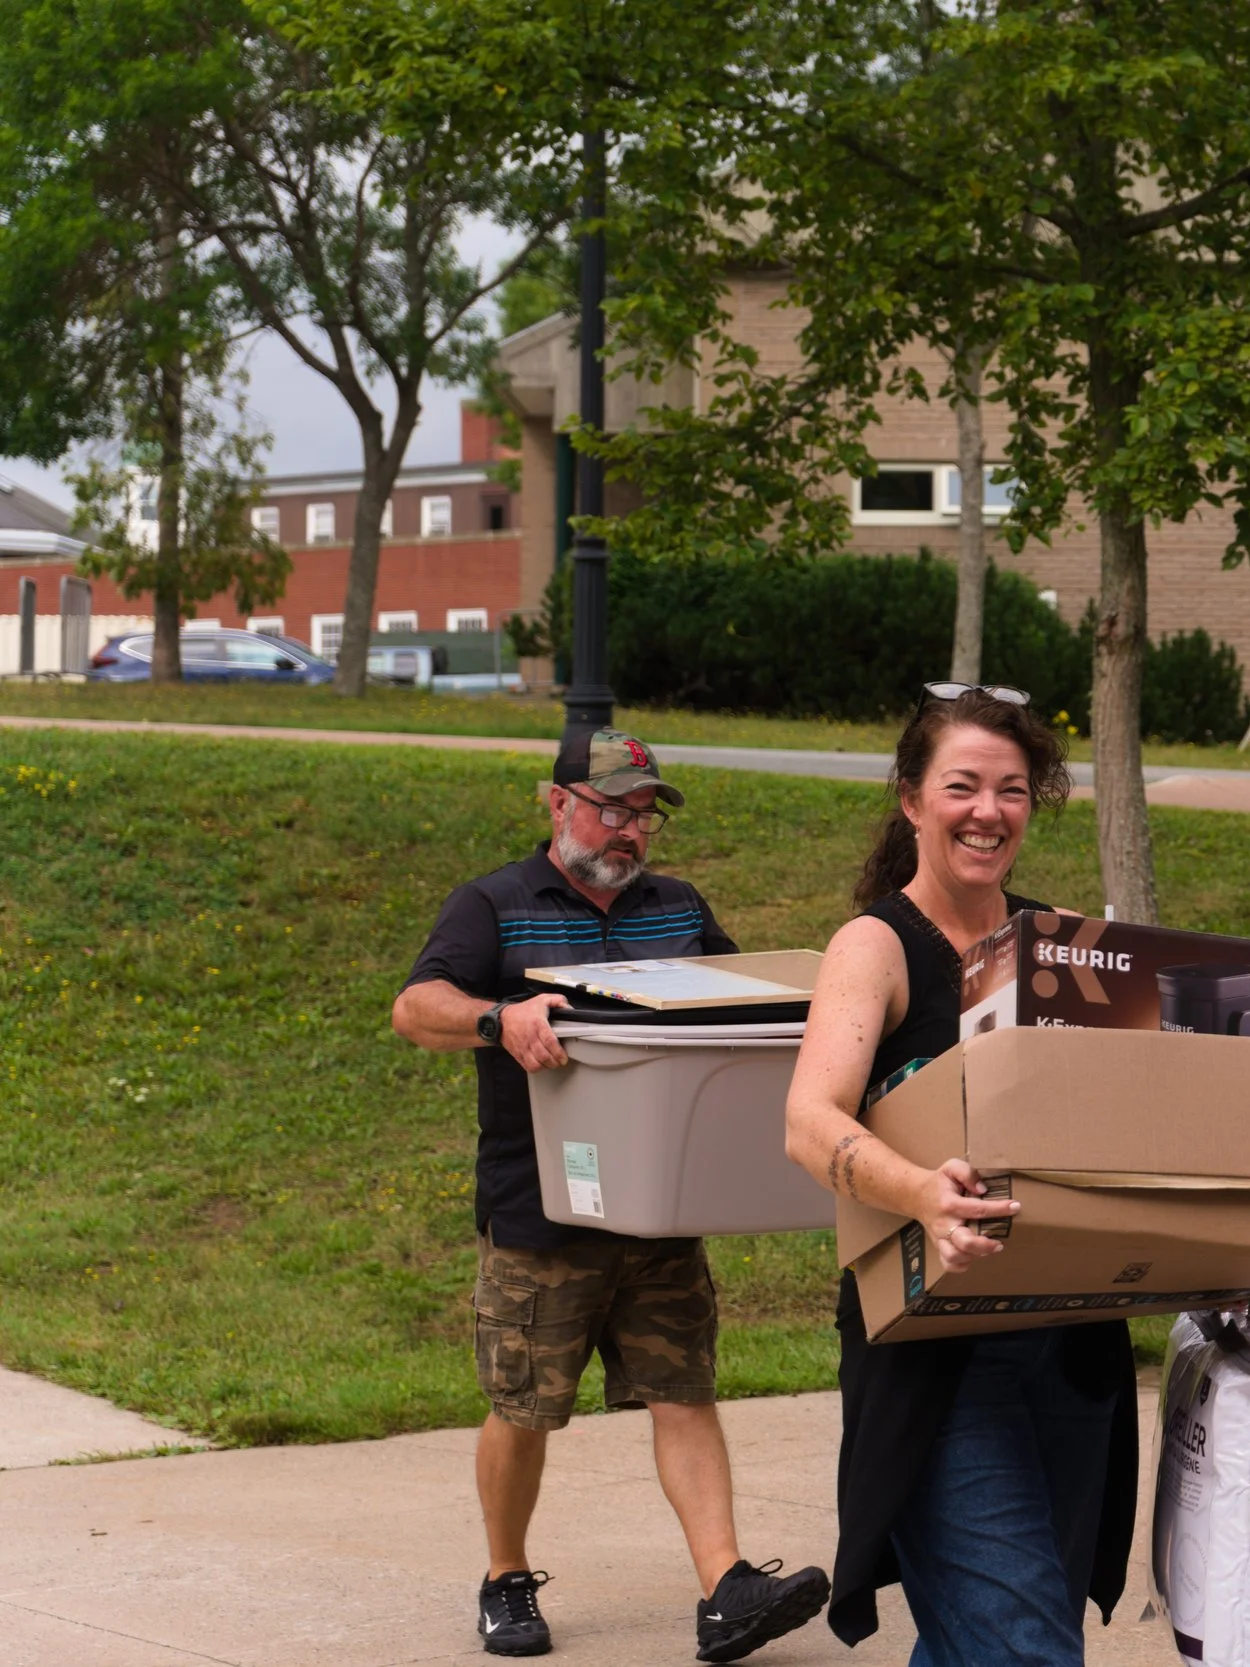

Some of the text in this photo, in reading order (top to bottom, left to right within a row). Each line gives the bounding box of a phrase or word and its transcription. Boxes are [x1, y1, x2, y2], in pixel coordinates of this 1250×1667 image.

[623, 740, 648, 767] B
[1038, 942, 1131, 972] KEURIG
[1161, 1018, 1195, 1034] KEURIG
